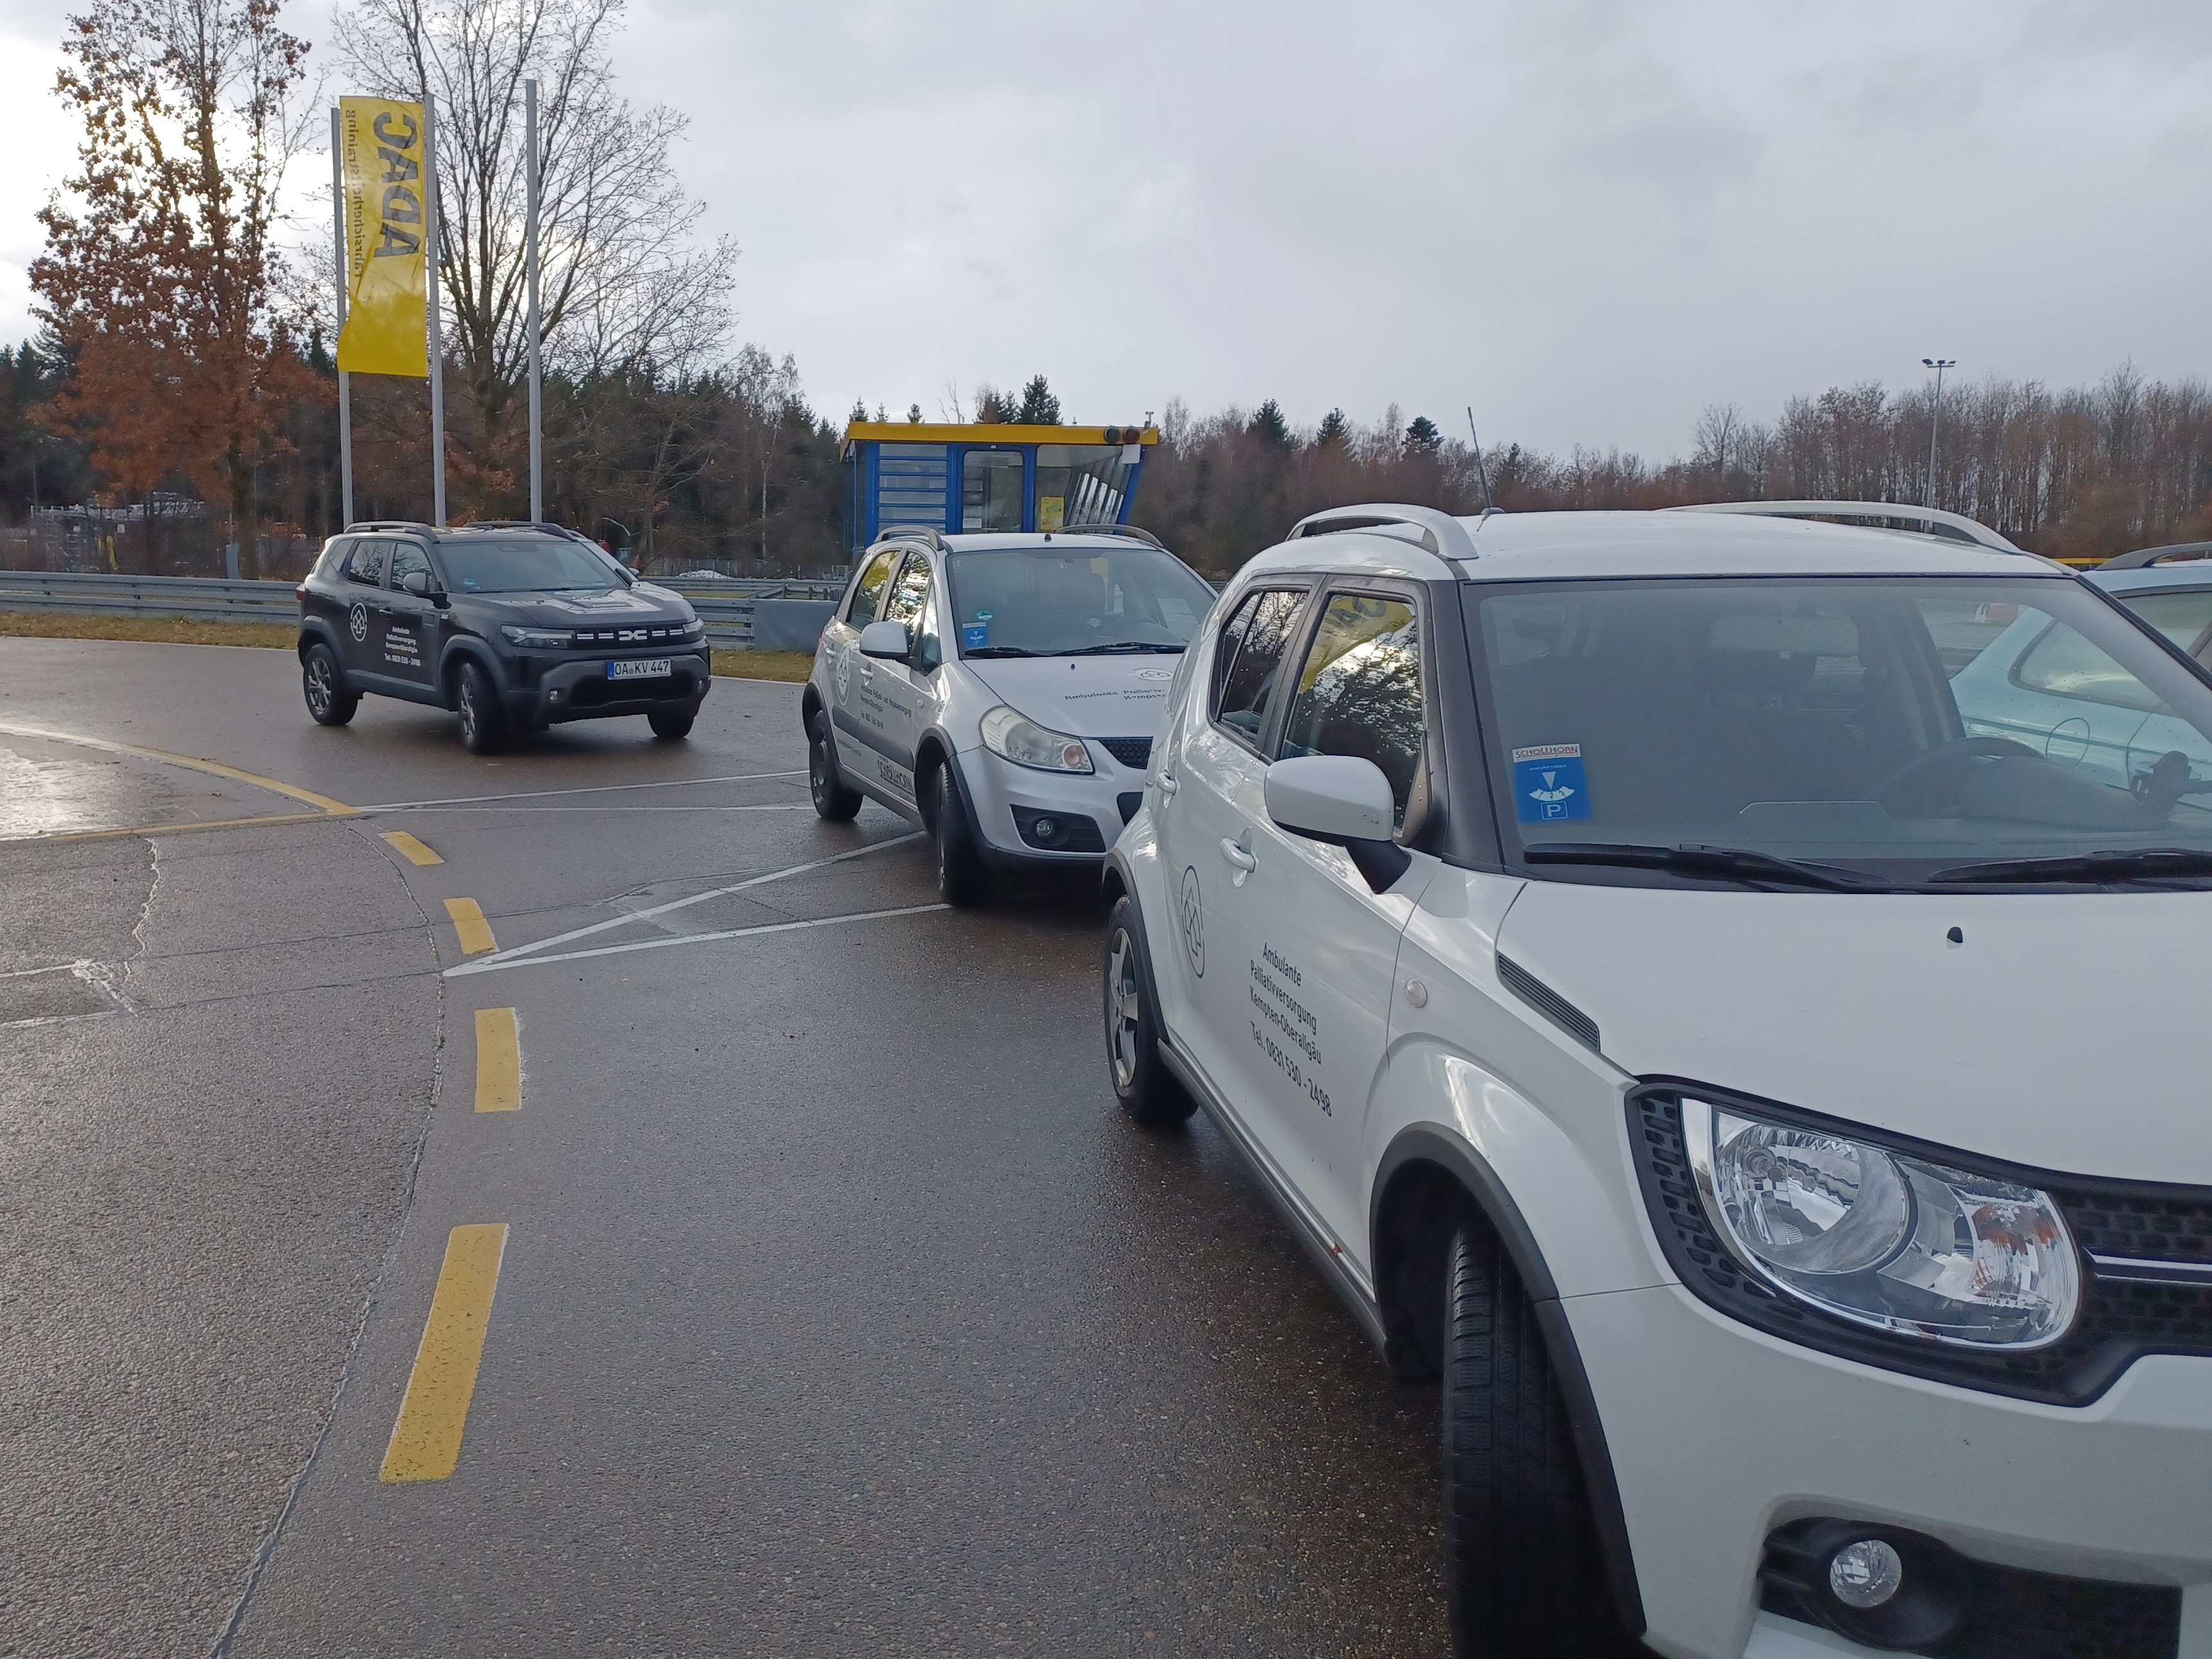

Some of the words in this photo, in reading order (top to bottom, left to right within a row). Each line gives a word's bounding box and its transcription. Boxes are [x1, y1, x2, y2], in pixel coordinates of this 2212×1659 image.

[615, 663, 628, 674] OA
[635, 662, 648, 673] KV
[651, 661, 669, 672] 447
[1065, 692, 1118, 701] Ambulante
[1547, 804, 1561, 817] P
[1263, 942, 1301, 987] Ambulante
[1251, 958, 1317, 1035] Palliativversorgung
[1250, 985, 1322, 1066] Kempten-Oberallgäu
[1250, 1020, 1266, 1051] Tel.
[1266, 1037, 1285, 1071] 0831
[1285, 1055, 1302, 1087] 530
[1308, 1077, 1332, 1117] 2498
